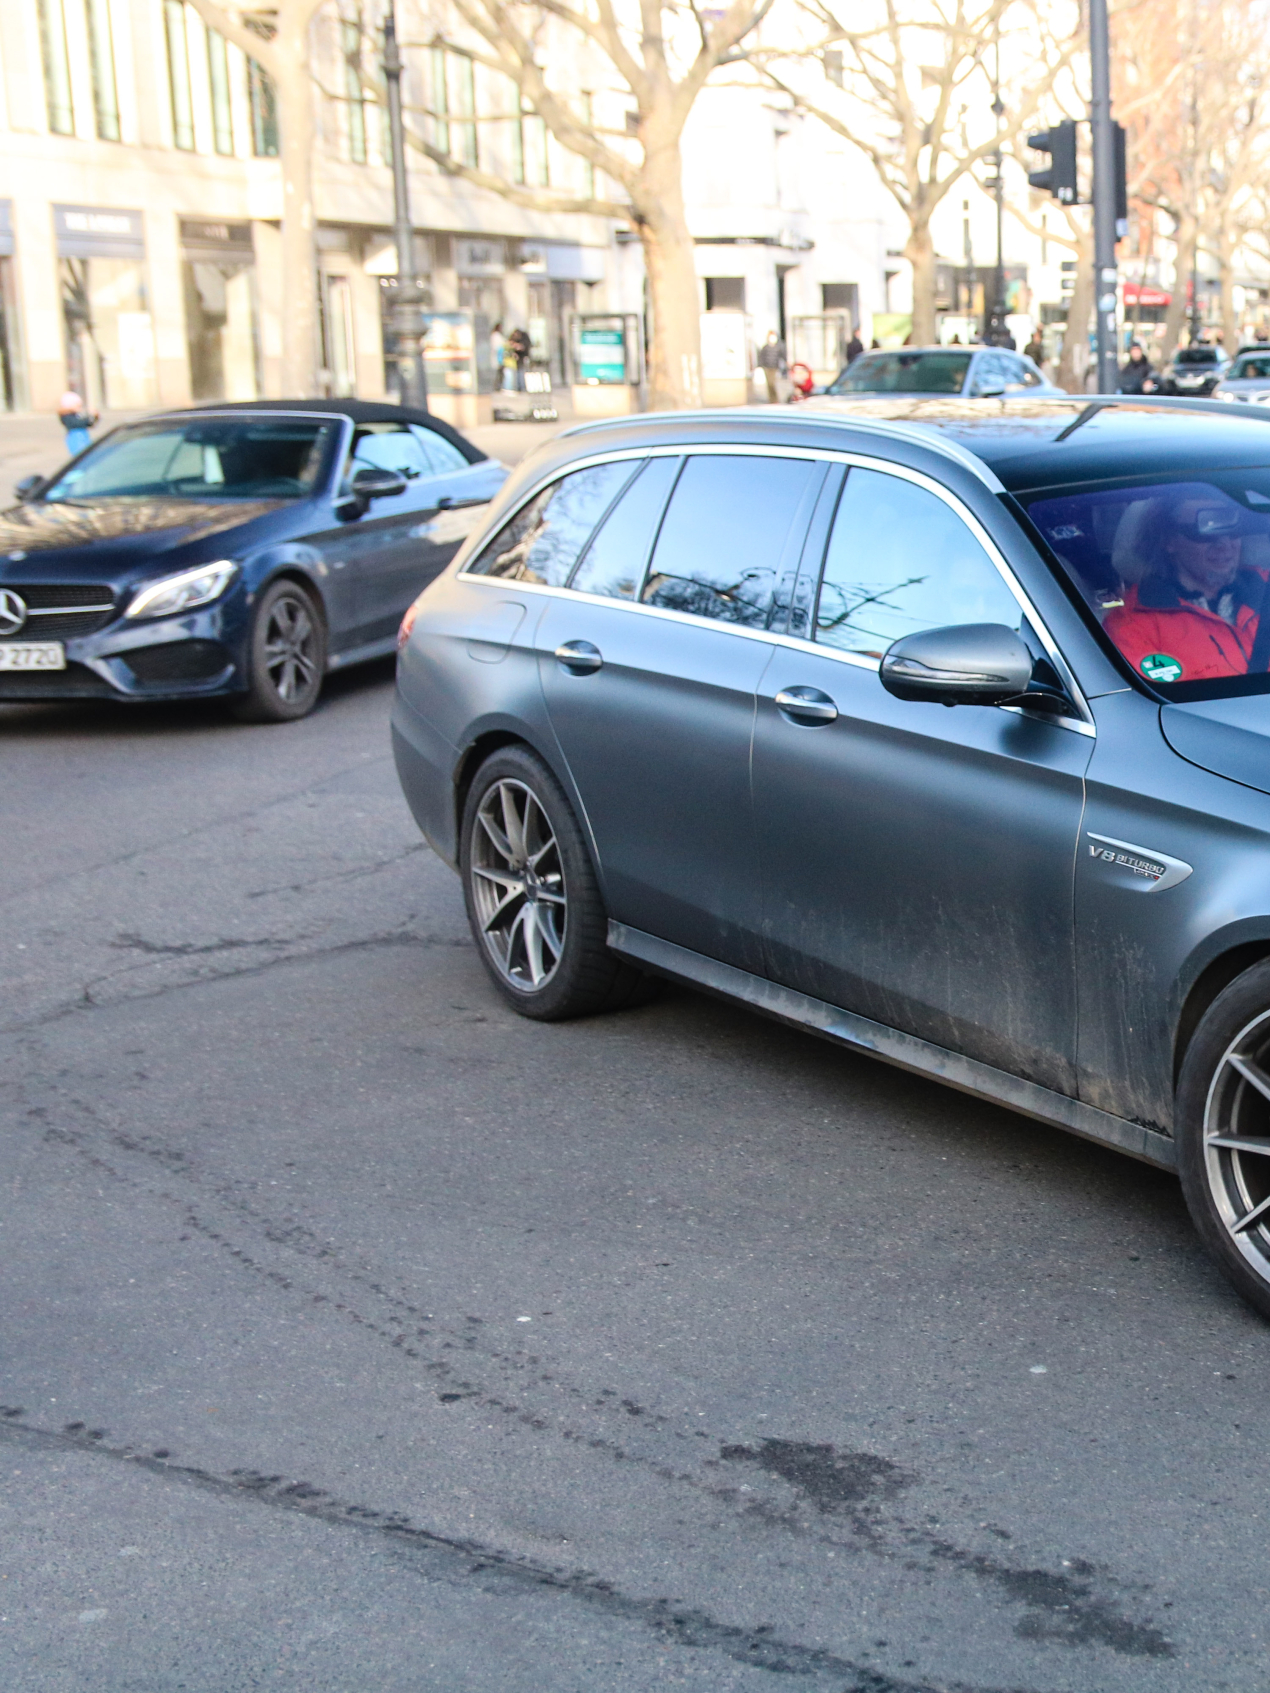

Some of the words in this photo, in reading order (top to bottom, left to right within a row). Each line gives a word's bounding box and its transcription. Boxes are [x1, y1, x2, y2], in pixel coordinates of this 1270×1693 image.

[10, 648, 58, 665] 2720
[1152, 655, 1165, 668] 4
[1089, 845, 1116, 863] V8
[1116, 854, 1165, 874] BITURBO
